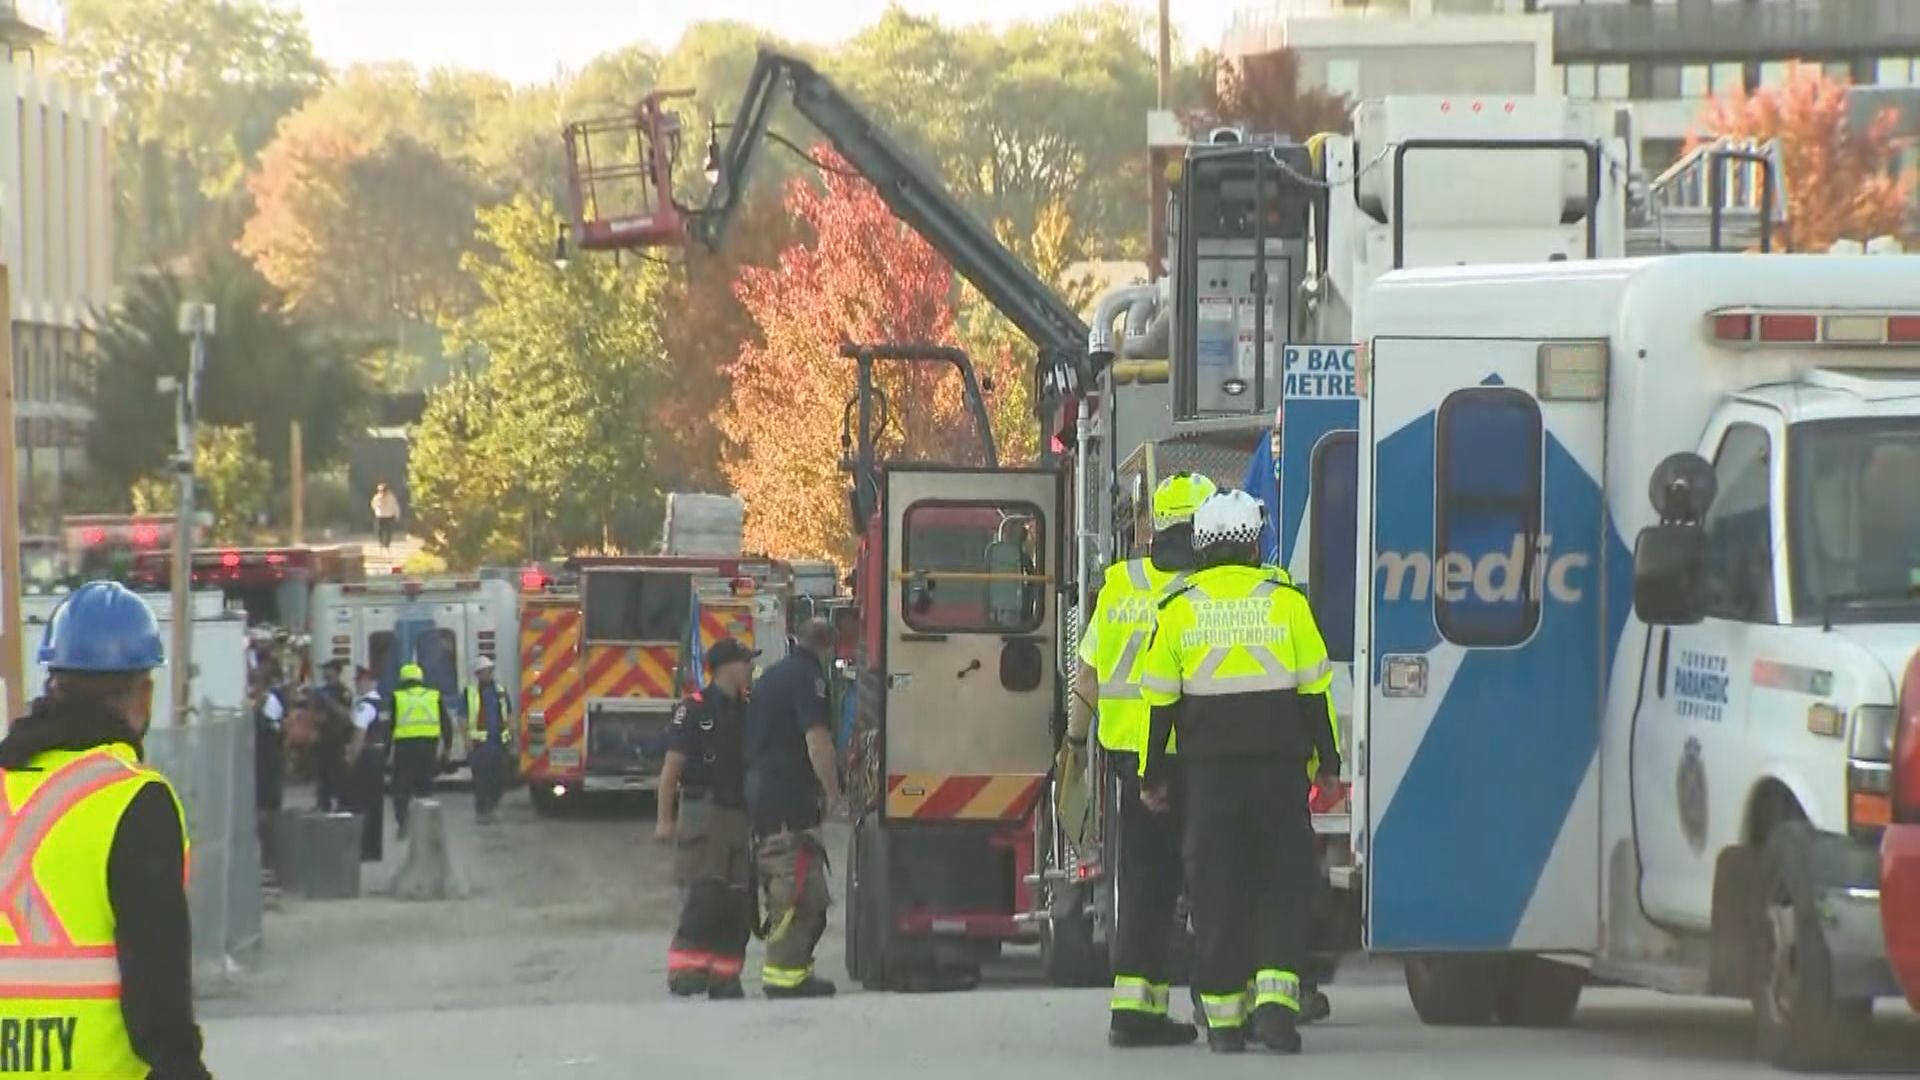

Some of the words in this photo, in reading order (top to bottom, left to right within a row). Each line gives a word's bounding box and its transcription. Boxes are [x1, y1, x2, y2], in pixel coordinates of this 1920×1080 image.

[1285, 349, 1299, 371] P
[1375, 533, 1589, 602] medic
[1193, 600, 1273, 611] TORONTO
[1198, 611, 1269, 627] PARAMEDIC
[1183, 627, 1287, 648] SUPERINTENDENT
[1675, 667, 1729, 704] PARAMEDIC
